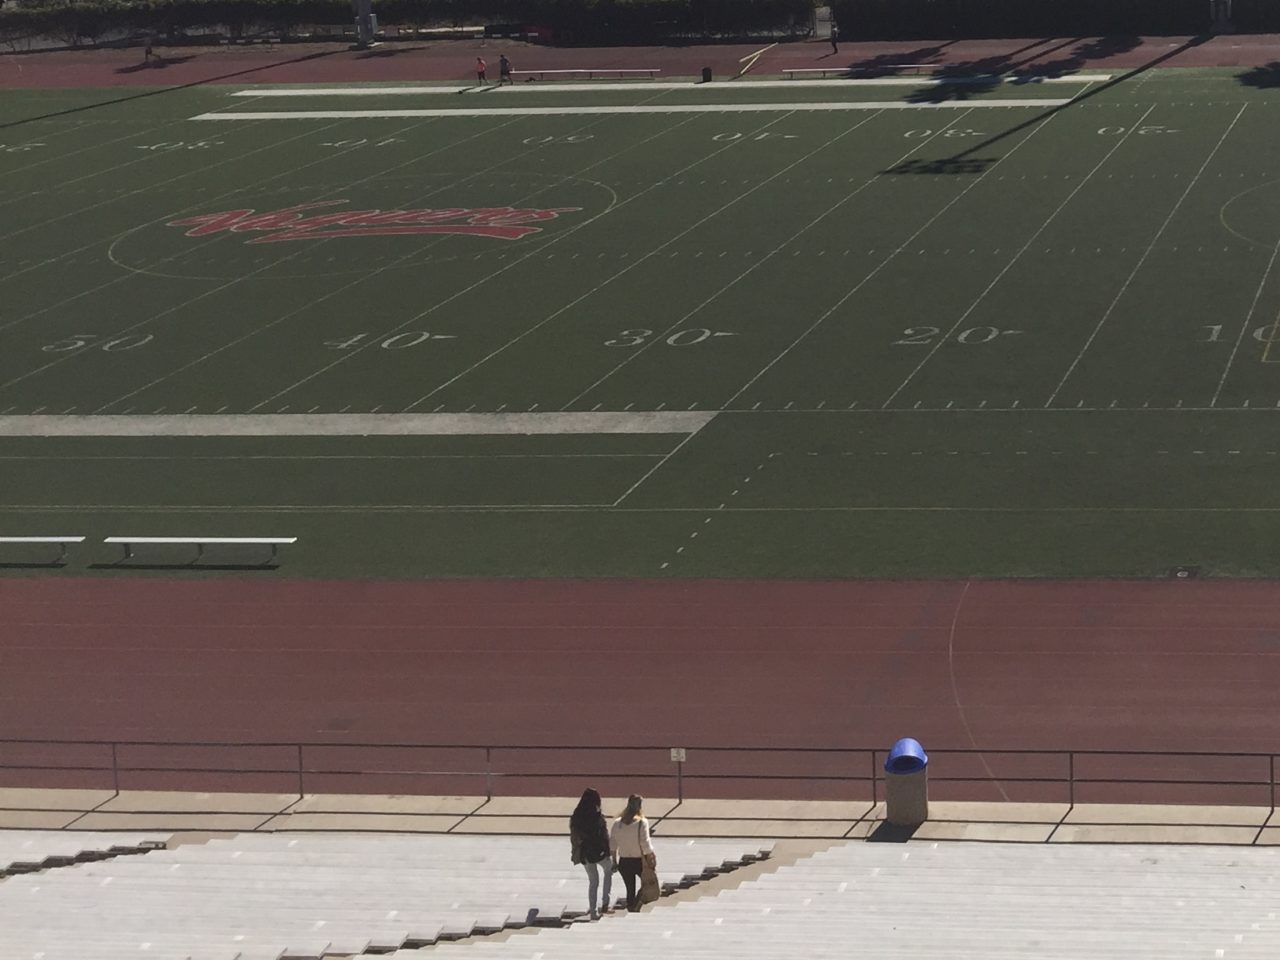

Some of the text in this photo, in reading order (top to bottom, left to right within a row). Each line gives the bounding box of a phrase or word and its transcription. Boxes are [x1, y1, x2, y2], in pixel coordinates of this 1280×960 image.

[41, 334, 154, 352] 50
[323, 331, 430, 349] 40
[604, 328, 711, 347] 30
[891, 326, 999, 344] 20
